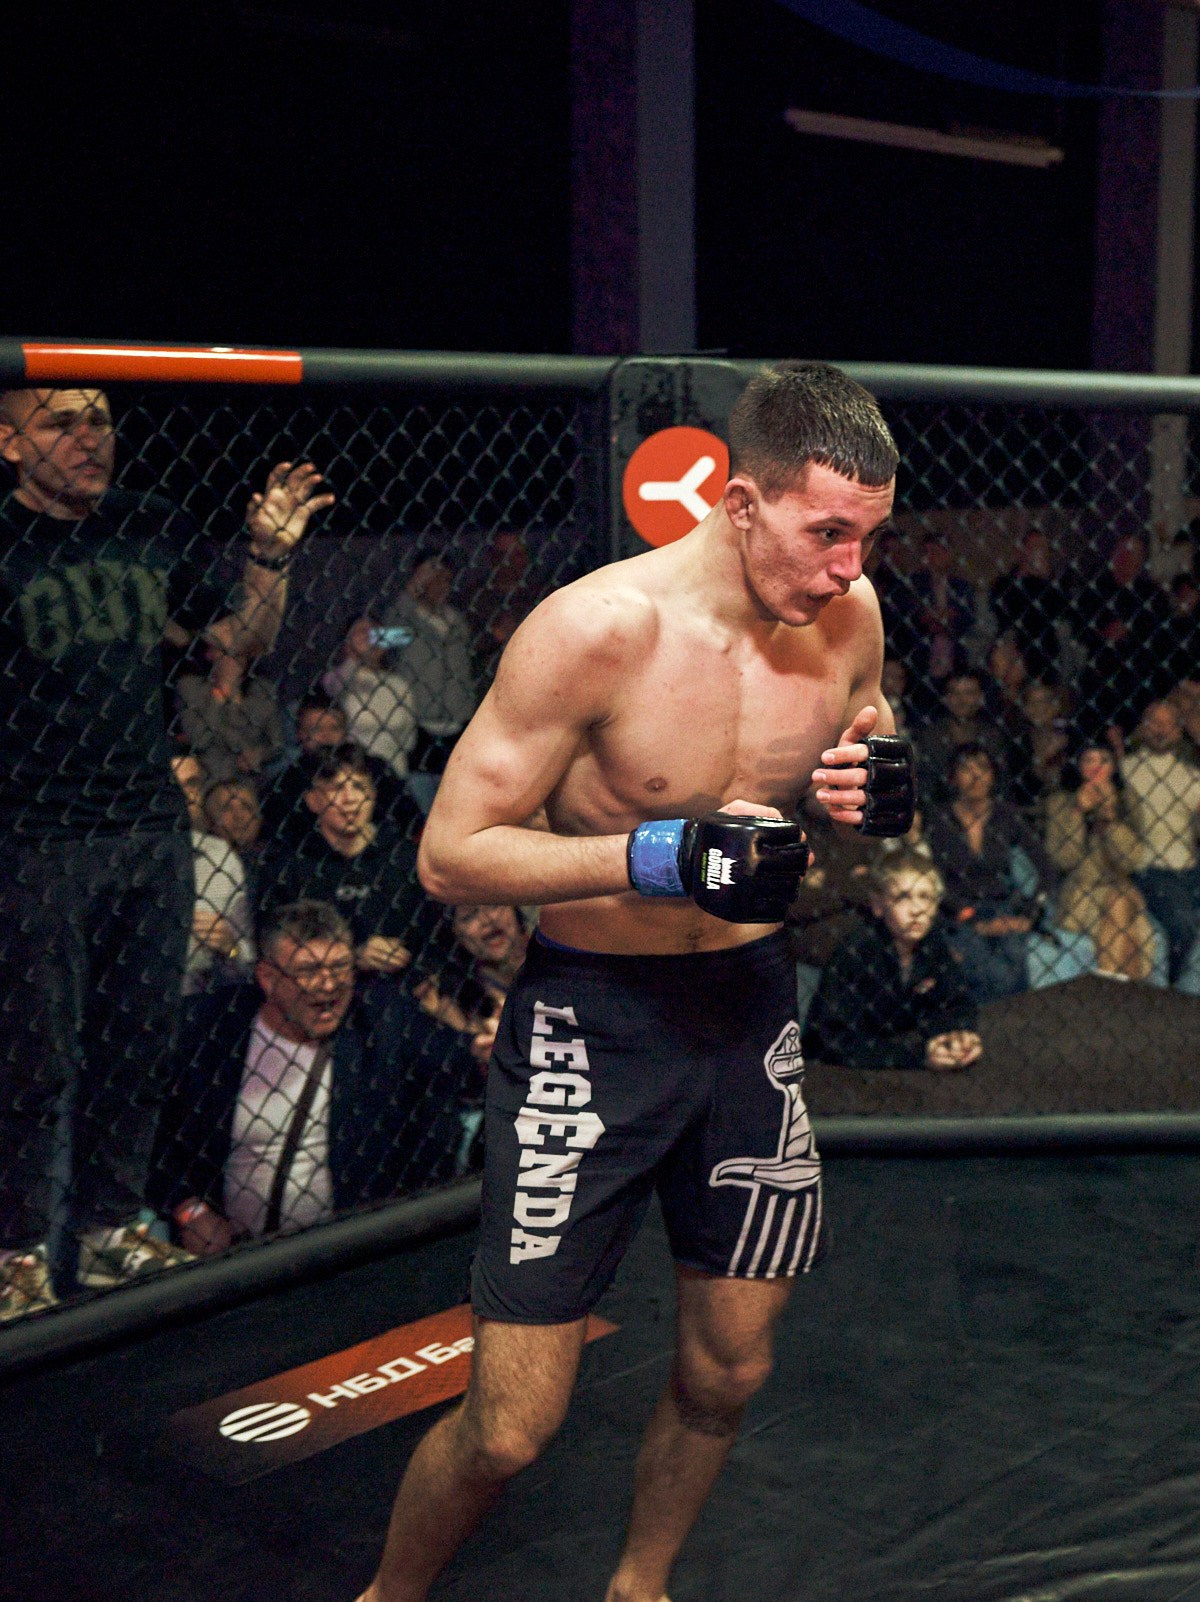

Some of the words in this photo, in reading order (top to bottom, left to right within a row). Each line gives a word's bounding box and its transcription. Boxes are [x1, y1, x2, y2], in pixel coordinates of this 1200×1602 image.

[706, 847, 723, 890] GORILLA
[509, 1000, 606, 1265] LEGENDA
[306, 1356, 428, 1408] НБД
[415, 1336, 476, 1365] Ба
